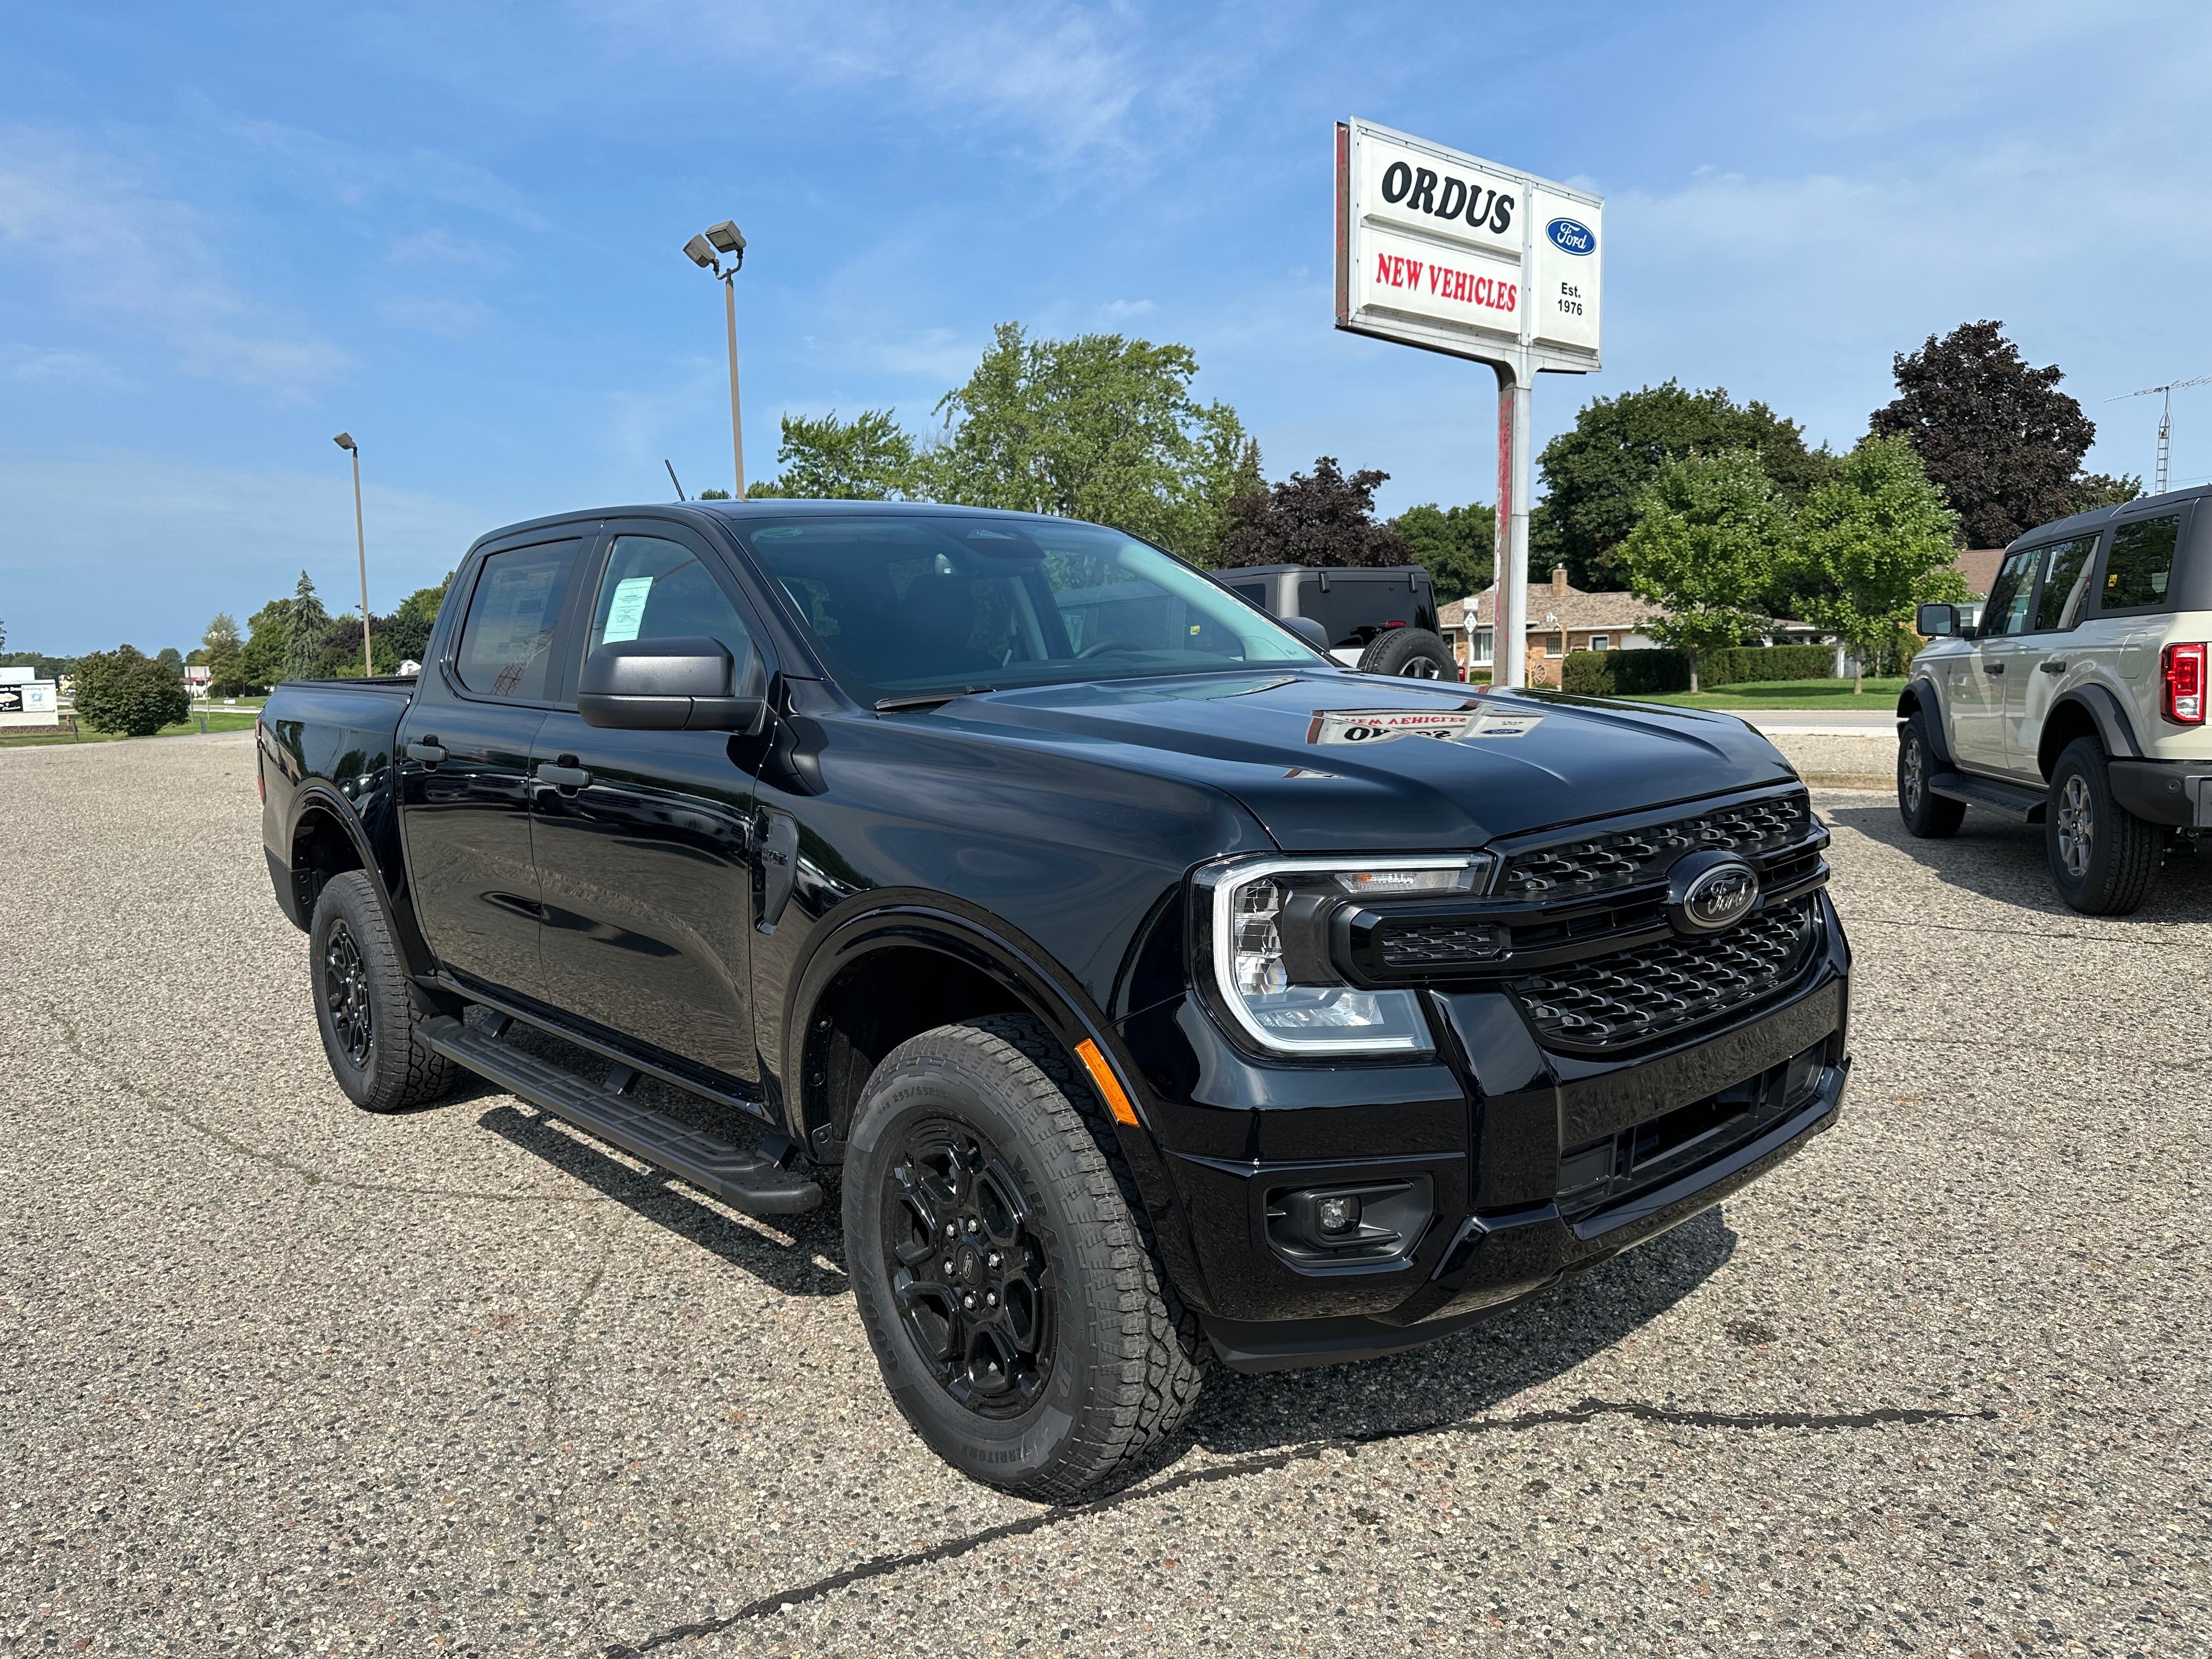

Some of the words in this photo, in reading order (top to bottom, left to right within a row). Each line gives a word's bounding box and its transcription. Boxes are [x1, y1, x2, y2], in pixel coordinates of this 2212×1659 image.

[1381, 161, 1514, 234] ORDUS
[1556, 222, 1587, 250] Ford
[1376, 253, 1423, 291] NEW
[1429, 264, 1516, 312] VEHICLES
[1561, 282, 1581, 298] Est.
[1558, 298, 1583, 315] 1976
[1707, 877, 1747, 915] Ford
